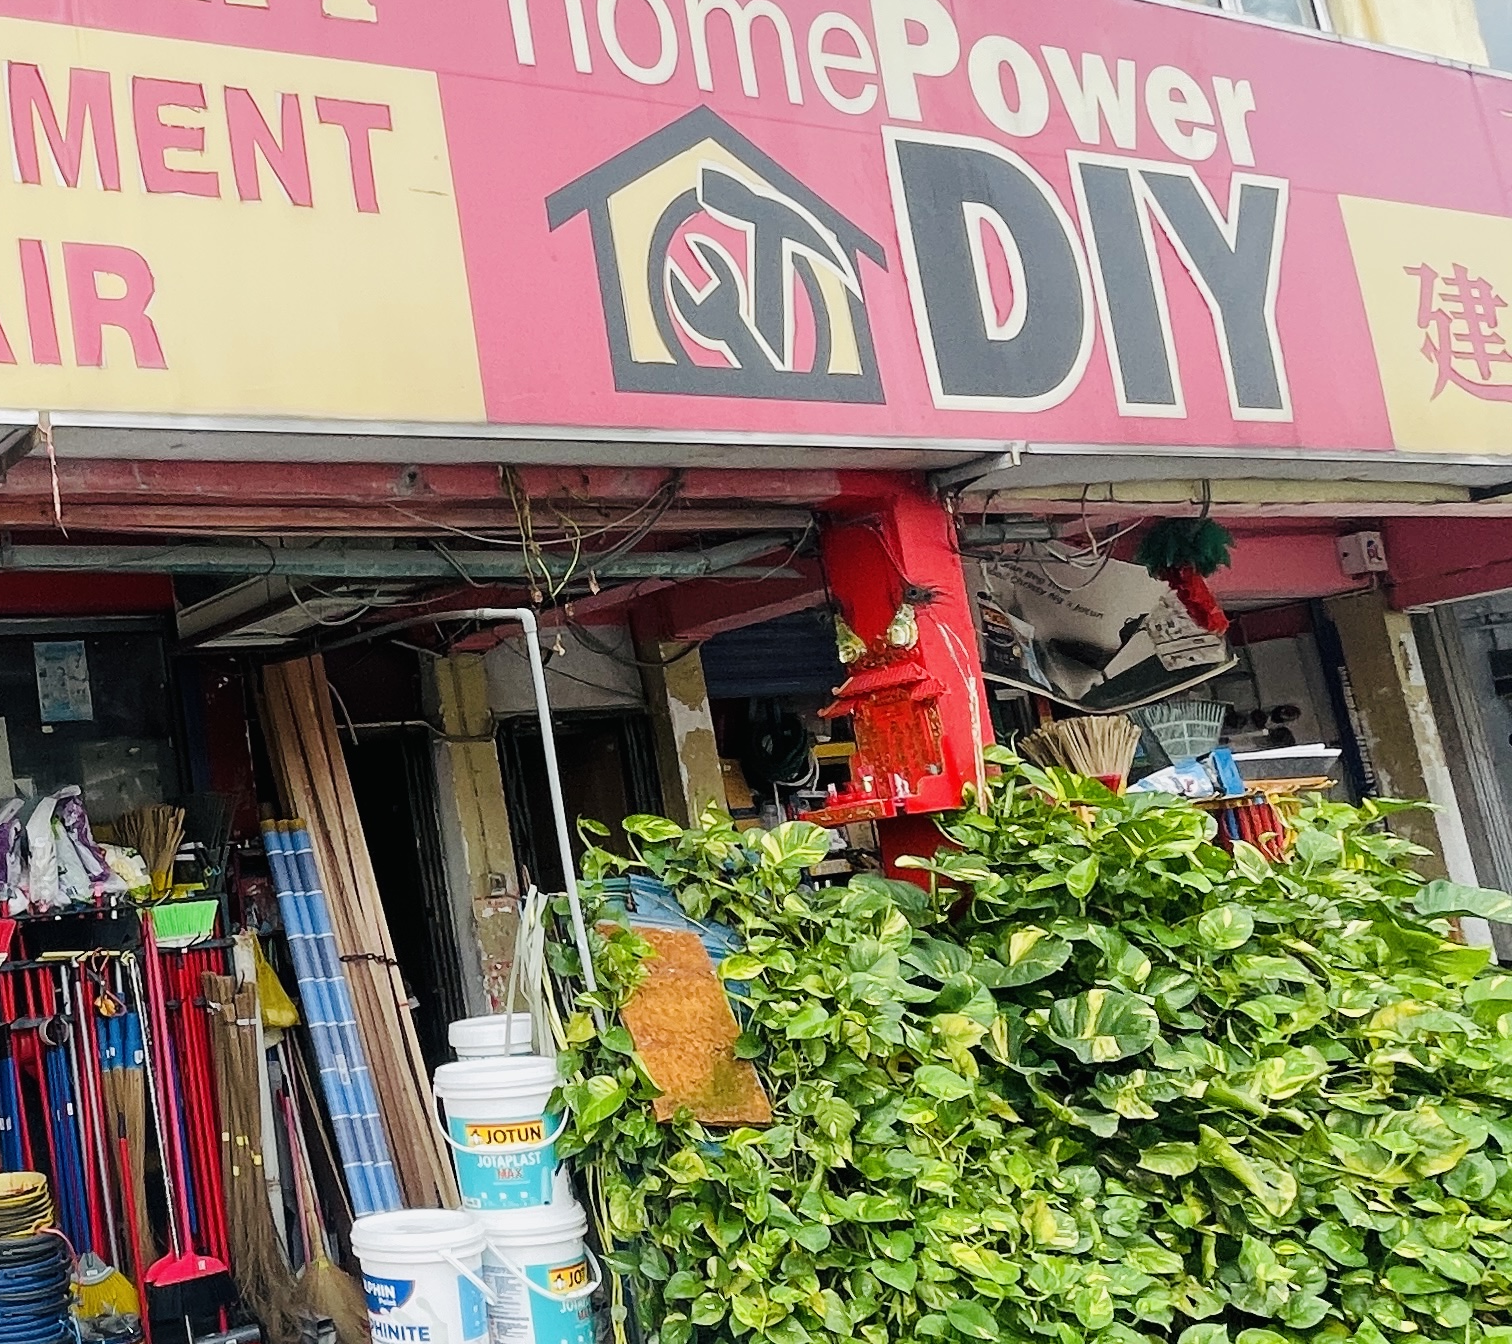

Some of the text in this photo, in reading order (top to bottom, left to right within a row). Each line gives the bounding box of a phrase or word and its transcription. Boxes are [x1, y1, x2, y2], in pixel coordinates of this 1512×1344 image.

[880, 123, 1292, 424] DIY
[486, 1125, 542, 1144] JOTUN
[477, 1151, 542, 1169] JOTAPLAST
